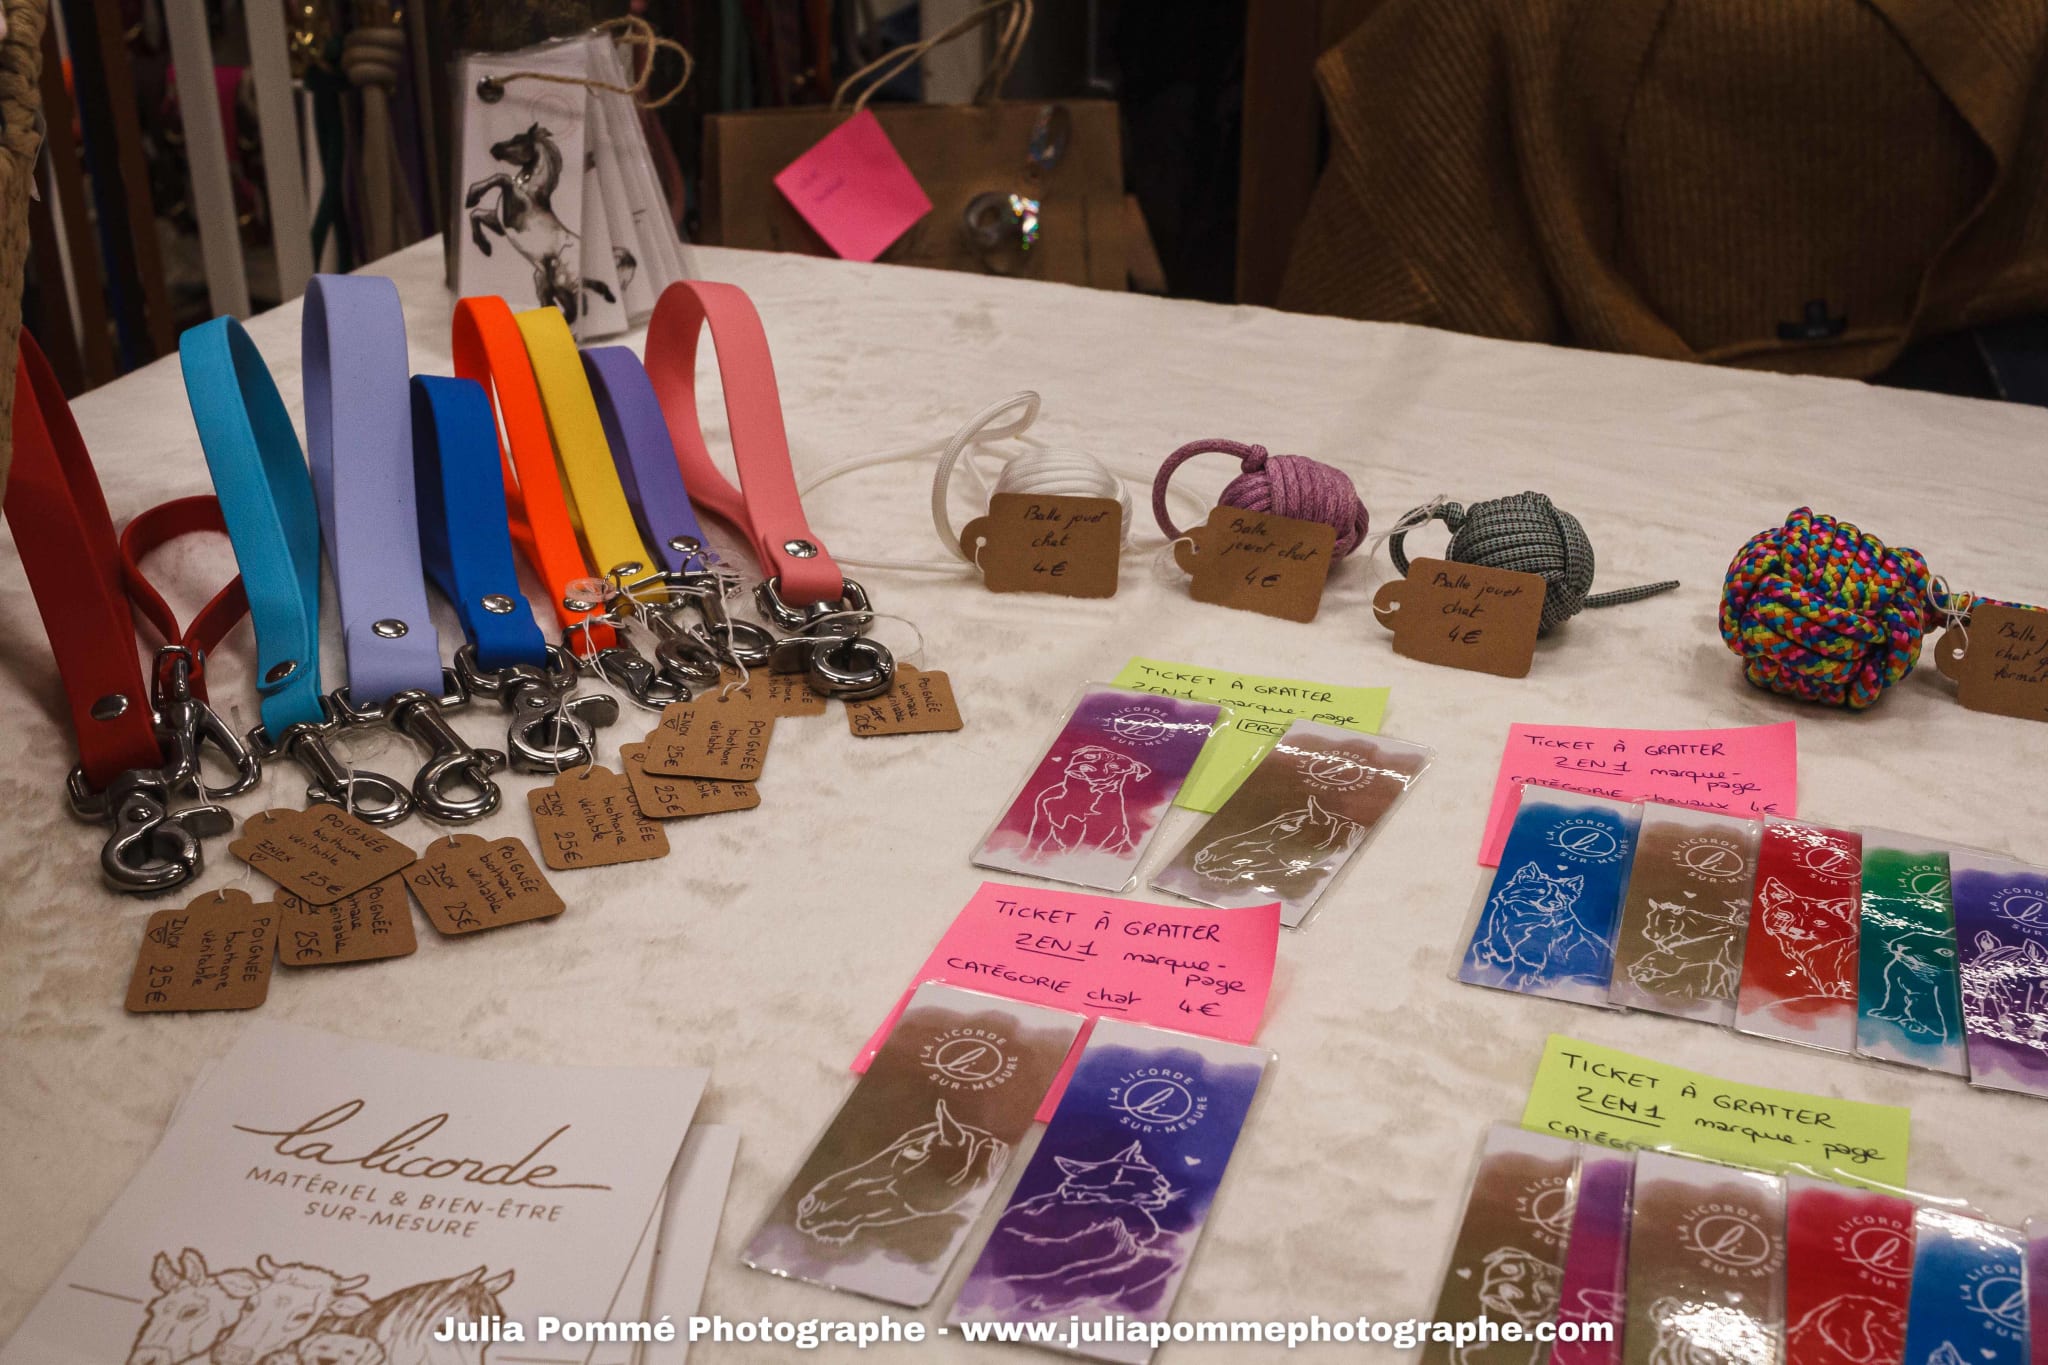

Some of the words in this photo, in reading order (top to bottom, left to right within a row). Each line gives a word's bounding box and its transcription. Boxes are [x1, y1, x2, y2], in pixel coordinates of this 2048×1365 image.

[1024, 505, 1061, 522] Balle
[1031, 533, 1069, 548] chat
[1278, 542, 1318, 561] chat
[1432, 572, 1471, 589] Balle
[1476, 581, 1523, 599] jouet
[1442, 602, 1484, 618] chat
[1141, 666, 1216, 685] TICKET
[1254, 685, 1334, 702] GRATTER
[664, 744, 686, 768] 25€
[1523, 734, 1595, 750] TICKET
[1644, 742, 1725, 756] GRATTER
[1707, 781, 1762, 796] page
[320, 813, 390, 853] POIGNÉE
[554, 831, 583, 864] 25€
[497, 845, 540, 893] POIGNÉE
[1992, 888, 2048, 898] LICORD
[444, 901, 481, 930] 25€
[996, 900, 1077, 924] TICKET
[1123, 921, 1221, 943] GRATTER
[242, 917, 272, 983] POIGNÉE
[294, 930, 323, 960] 25€
[145, 965, 173, 1004] 25€
[947, 957, 1072, 993] CATÉGORIE
[1087, 987, 1142, 1005] chat
[1185, 974, 1246, 995] page
[920, 1045, 934, 1058] LA
[934, 1028, 1007, 1045] LICORDE
[929, 1056, 1018, 1090] SUR-MESURE
[1108, 1087, 1121, 1100] LA
[1120, 1068, 1194, 1084] LICORDE
[1560, 1052, 1660, 1089] TICKET
[1713, 1094, 1836, 1129] GRATTER
[1120, 1096, 1207, 1133] SUR-MESURE
[246, 1166, 384, 1202] MATÉRIEL
[389, 1190, 408, 1206] &
[419, 1194, 564, 1223] BIEN-ÊTRE
[304, 1202, 479, 1238] SUR-MESURE
[1682, 1204, 1760, 1223] LICORDE
